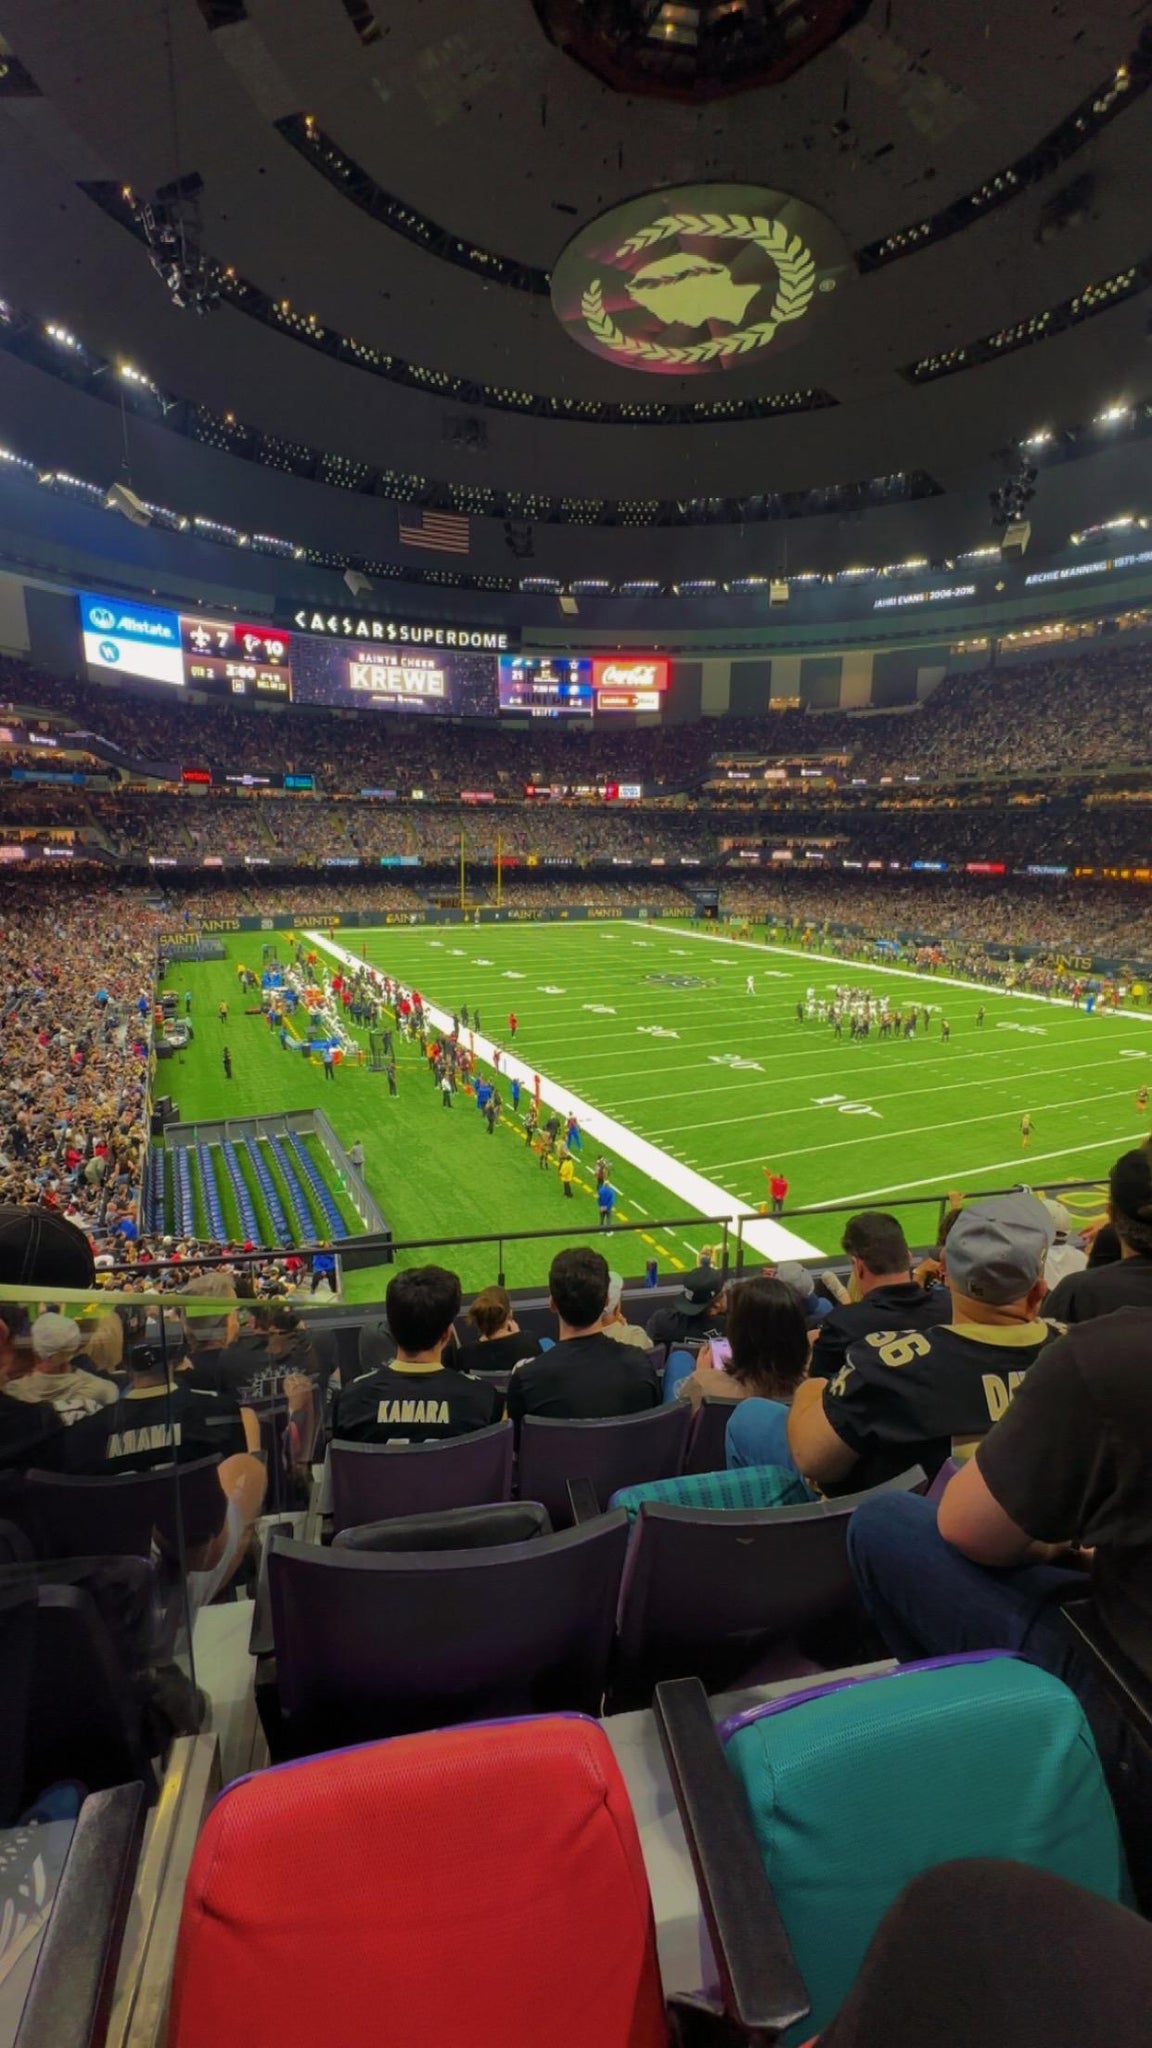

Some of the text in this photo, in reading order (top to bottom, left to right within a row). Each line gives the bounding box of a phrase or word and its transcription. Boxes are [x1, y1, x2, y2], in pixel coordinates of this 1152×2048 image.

[1060, 560, 1107, 578] MANNING
[295, 611, 509, 649] CAESARS SUPERDOME
[216, 631, 230, 648] 7
[264, 639, 284, 657] 10
[401, 657, 434, 669] CHEER
[207, 667, 215, 679] 2
[352, 664, 443, 697] KREWE
[588, 907, 623, 919] SAINTS
[662, 907, 697, 918] SAINTS
[810, 1094, 873, 1114] 10
[377, 1400, 449, 1424] KAMARA
